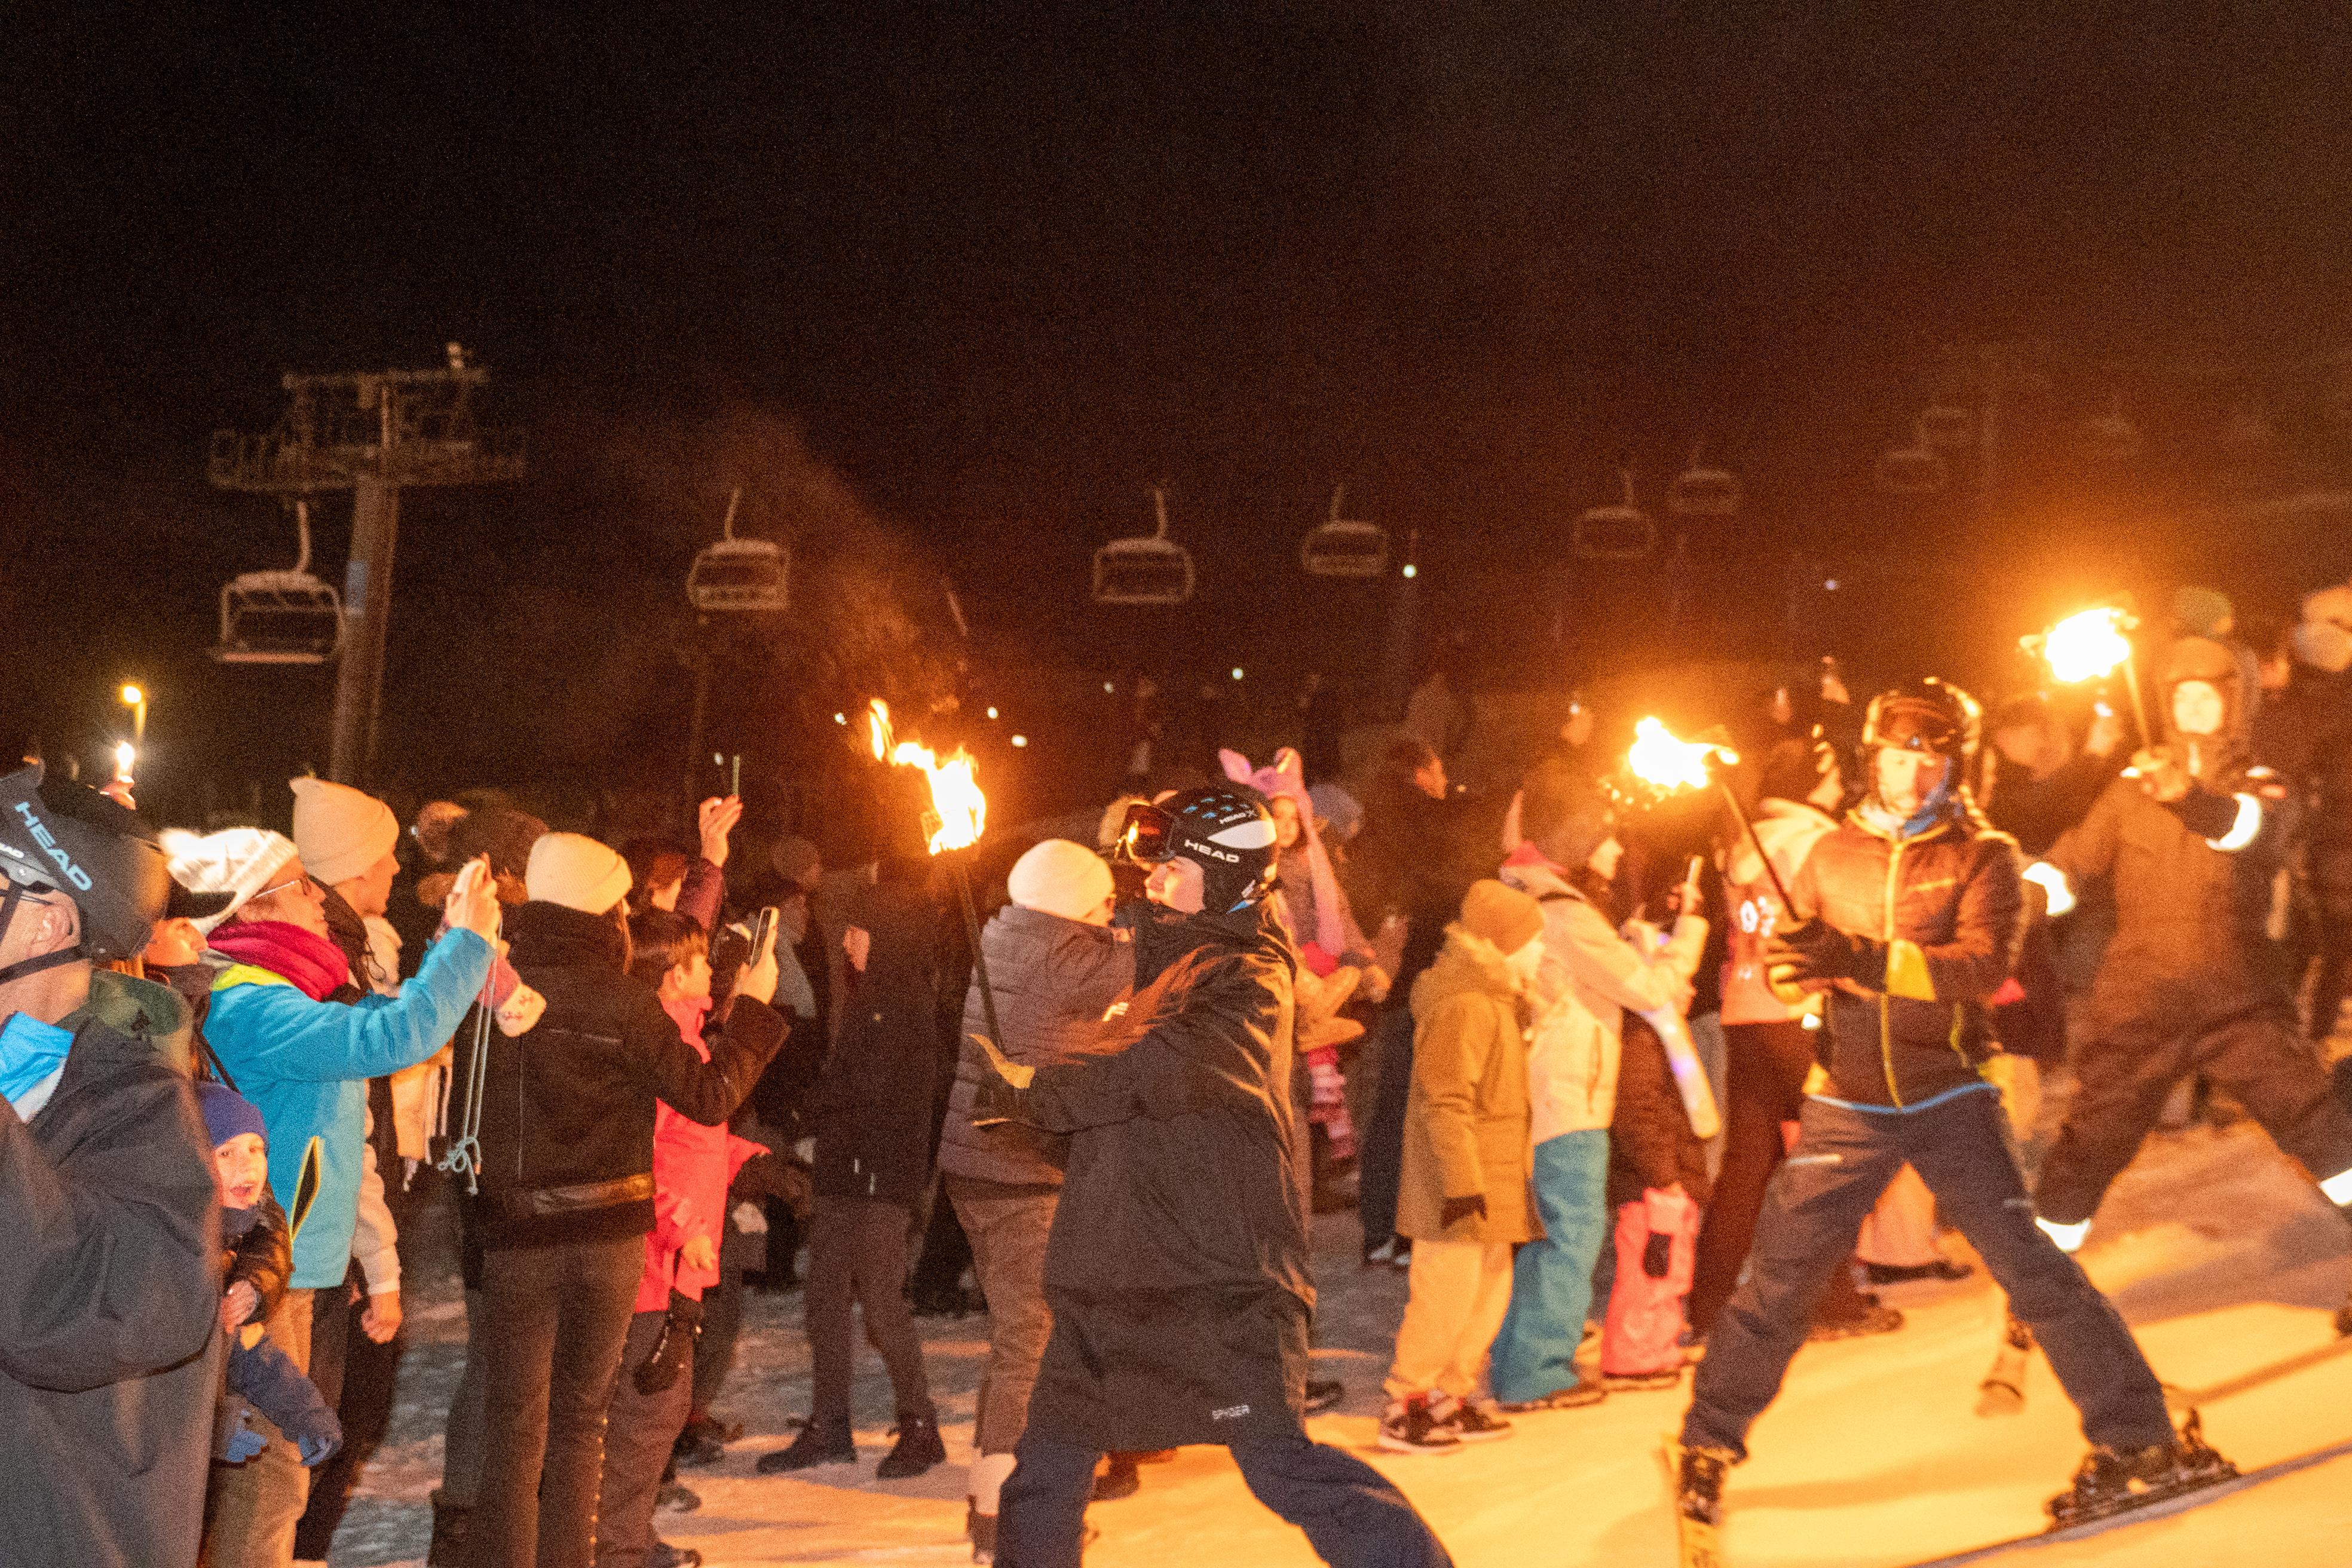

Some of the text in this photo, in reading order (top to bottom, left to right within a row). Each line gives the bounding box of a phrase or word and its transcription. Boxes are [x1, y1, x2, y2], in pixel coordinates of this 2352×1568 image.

[1219, 813, 1247, 824] HEAD
[14, 801, 93, 891] HEAD
[1184, 839, 1239, 863] HEAD
